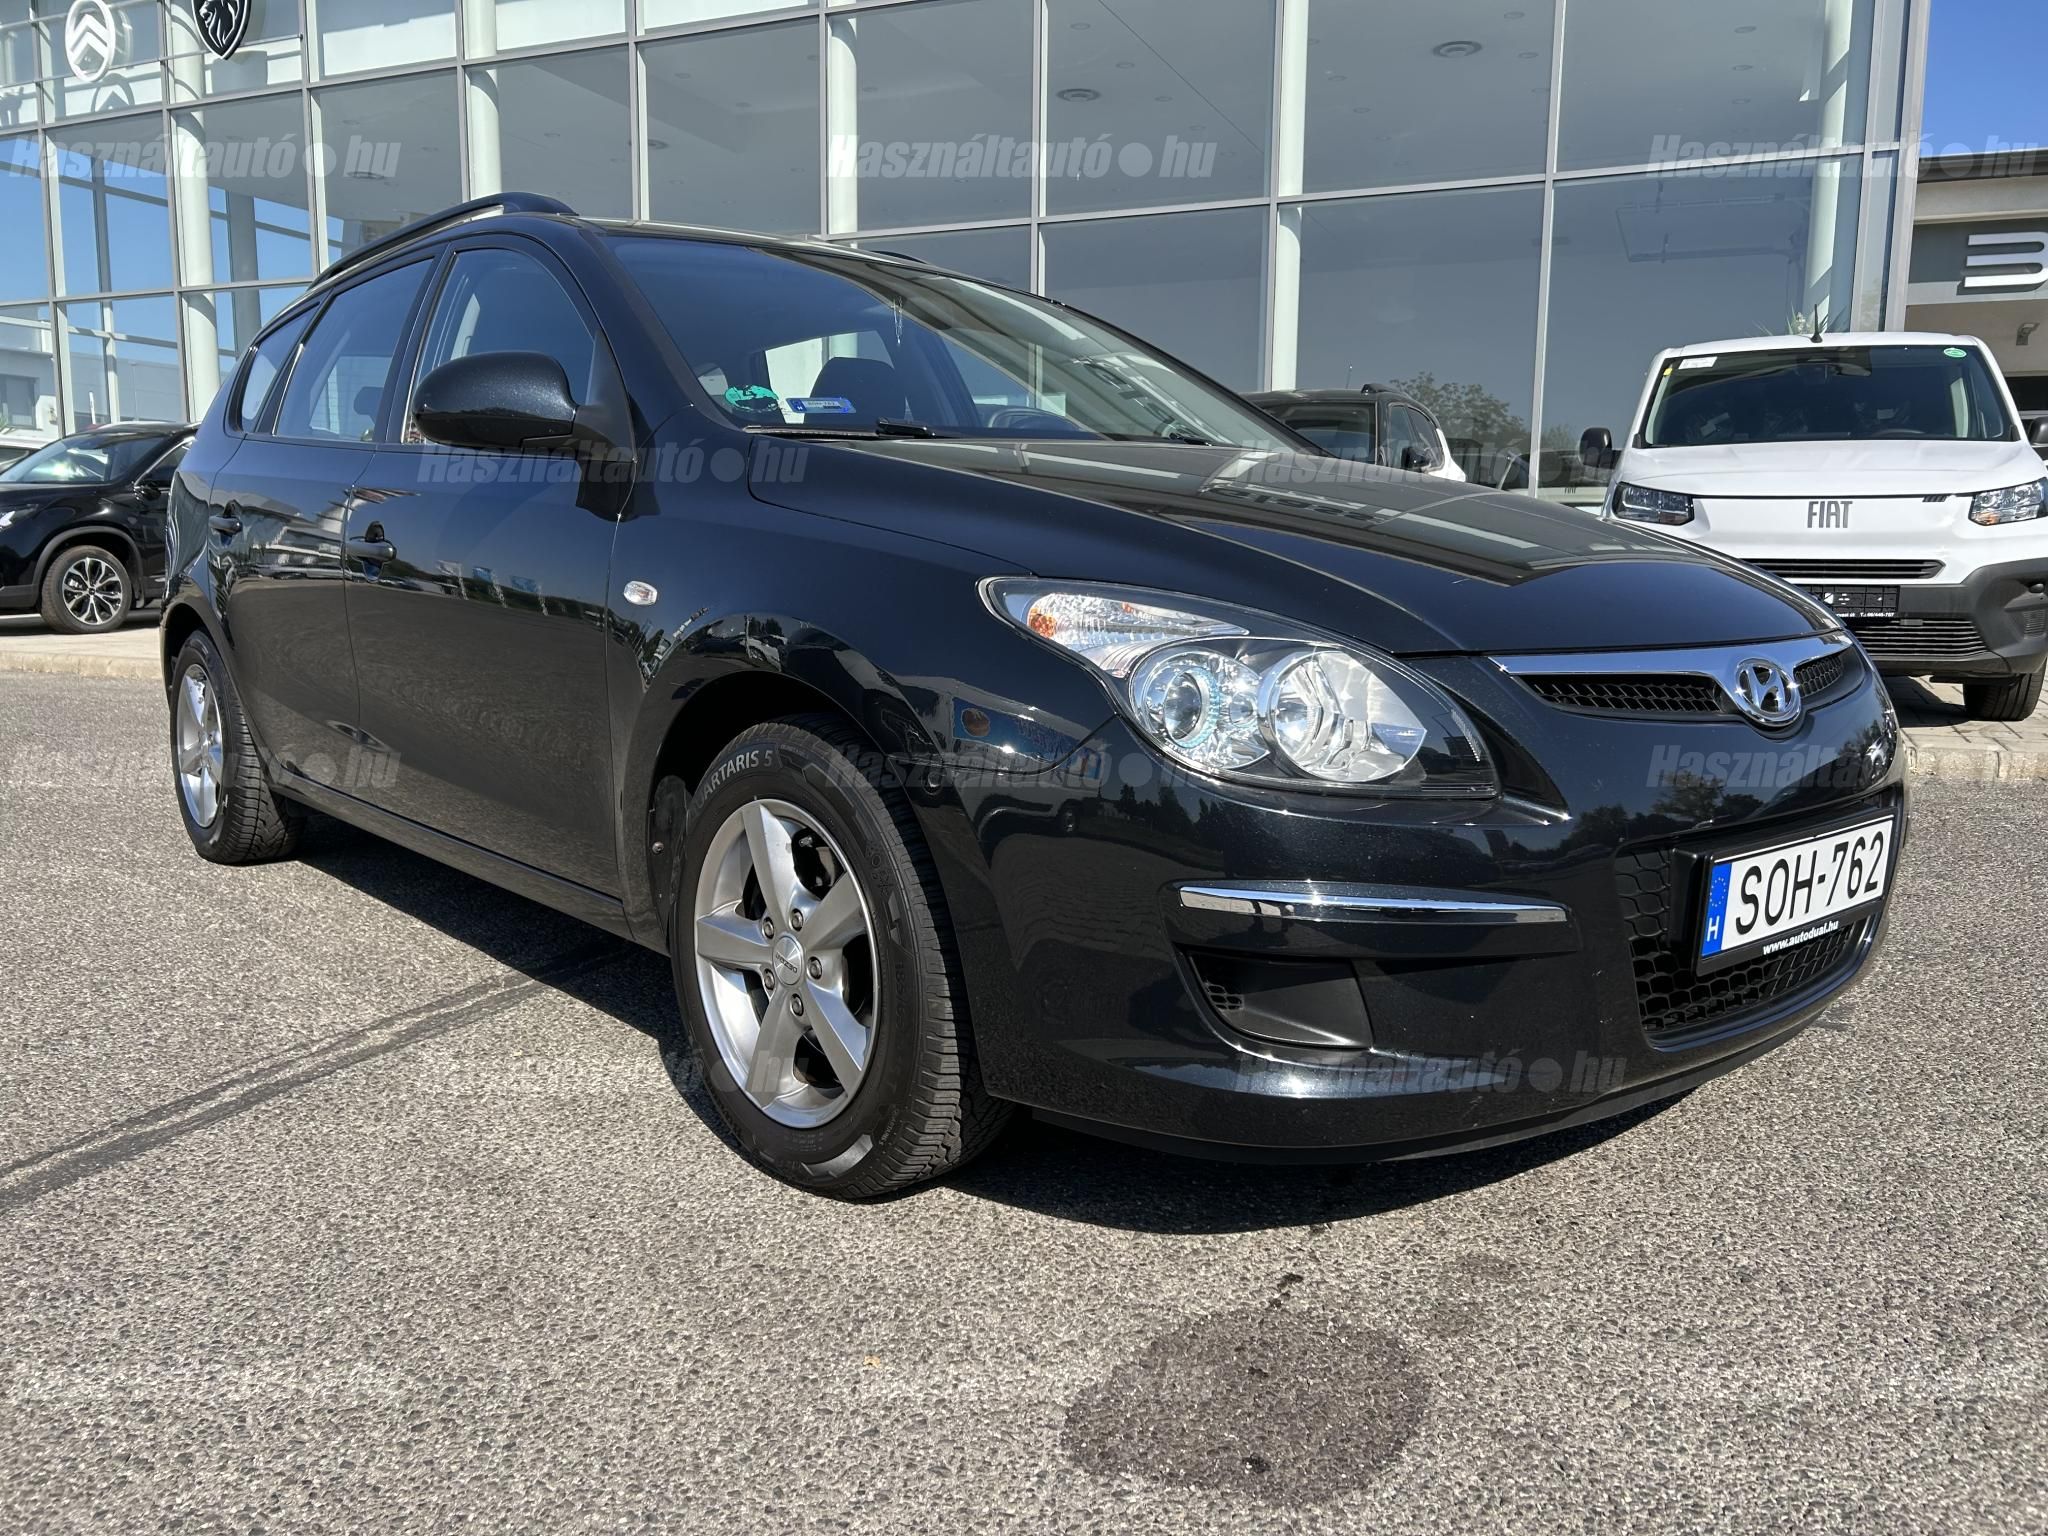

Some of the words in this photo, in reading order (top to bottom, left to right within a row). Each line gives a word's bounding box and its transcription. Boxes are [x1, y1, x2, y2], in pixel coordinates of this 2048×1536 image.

[1807, 501, 1853, 528] FIAT
[1735, 831, 1884, 935] SOH-762
[1706, 916, 1720, 942] H
[1762, 920, 1839, 955] www.autodual.hu
